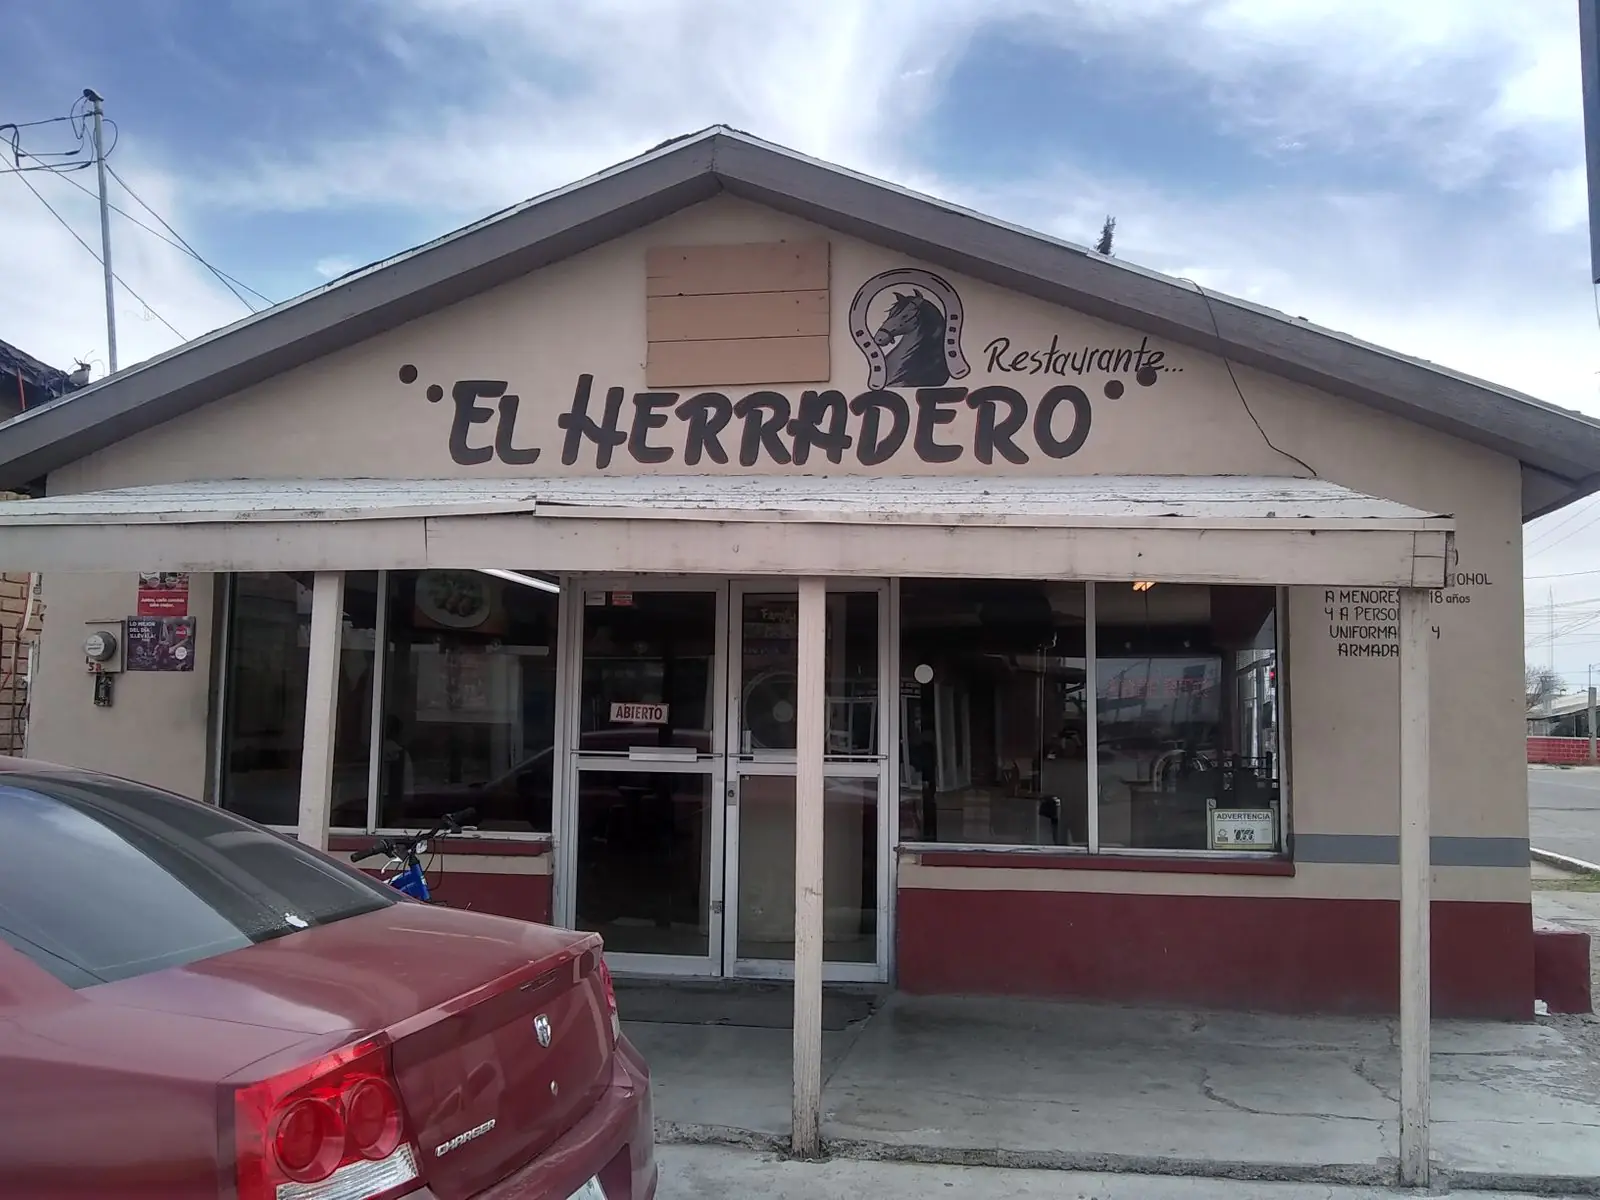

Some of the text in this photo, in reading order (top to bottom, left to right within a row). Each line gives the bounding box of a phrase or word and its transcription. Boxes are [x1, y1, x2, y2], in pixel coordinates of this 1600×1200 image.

[449, 373, 1093, 468] EL HERRADERO
[1456, 572, 1493, 585] OHOL
[1325, 590, 1335, 603] A
[1446, 593, 1471, 603] años
[1340, 606, 1349, 621] A
[1329, 625, 1399, 639] UNIFORMA
[1337, 643, 1400, 657] ARMADA
[615, 705, 663, 720] ABIERTO
[435, 1118, 497, 1158] CHARGER
